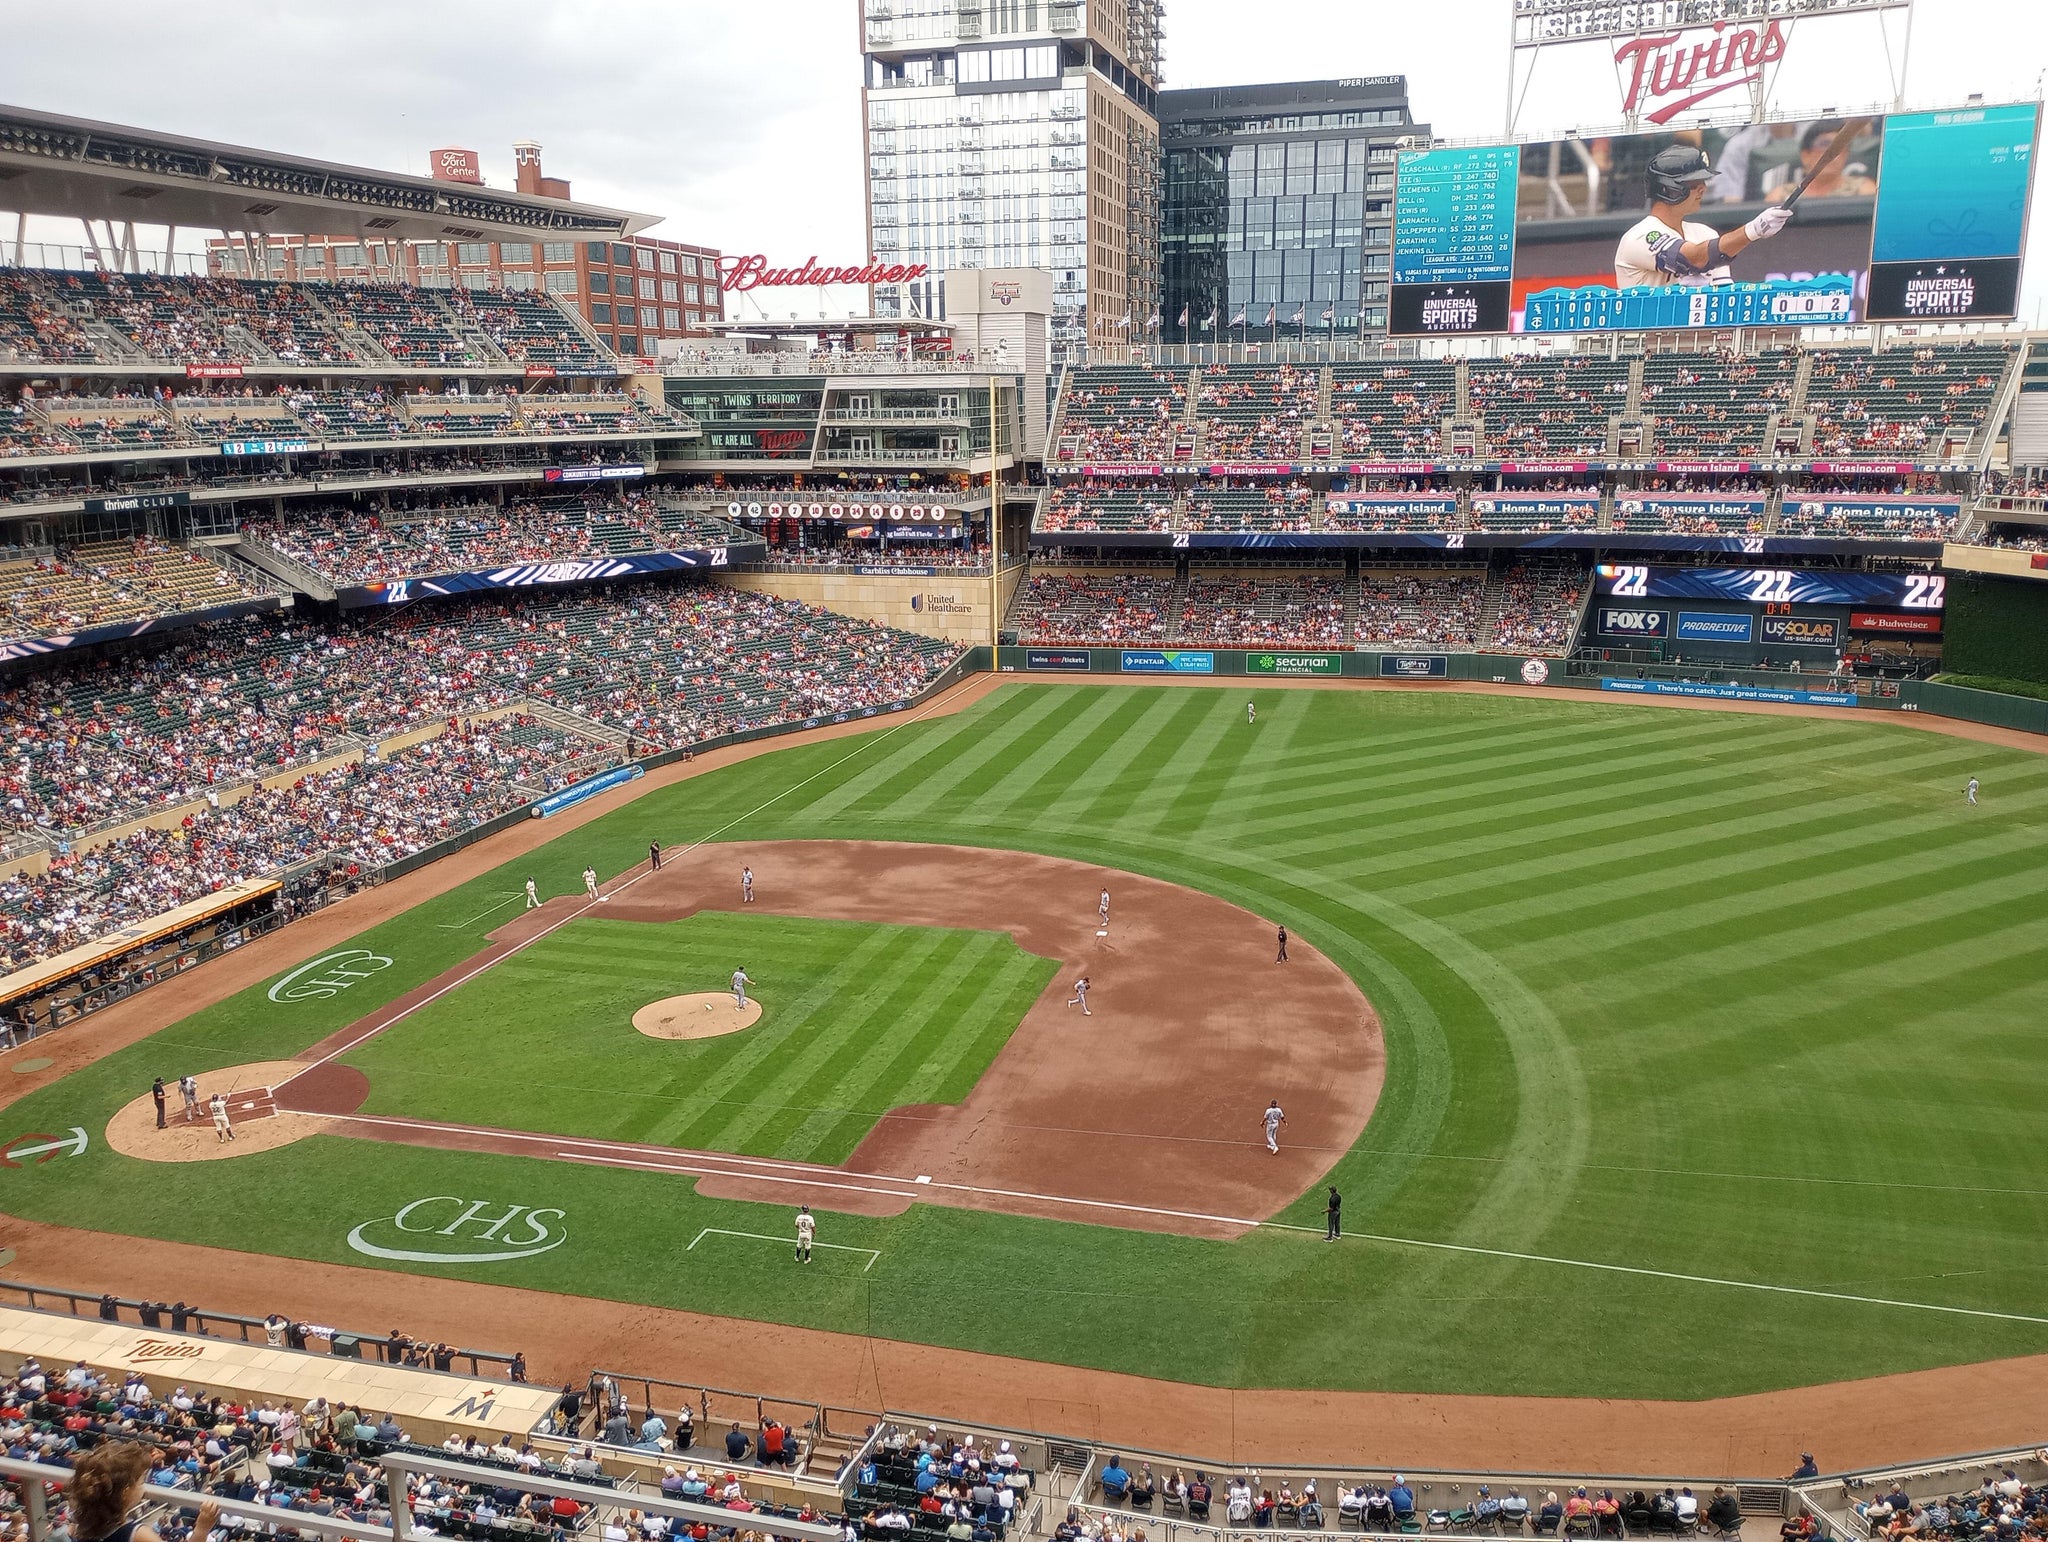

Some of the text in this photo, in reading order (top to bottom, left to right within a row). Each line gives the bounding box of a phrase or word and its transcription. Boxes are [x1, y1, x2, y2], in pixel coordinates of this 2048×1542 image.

[1615, 20, 1786, 124] Twins
[1366, 76, 1399, 85] SANDLER
[441, 152, 465, 166] Ford
[446, 166, 475, 176] Center
[714, 254, 928, 291] Budweiser
[1908, 278, 1974, 290] UNIVERSAL
[1424, 298, 1477, 309] UNIVERSAL
[1695, 295, 1769, 307] 2 2 0 3 4
[1780, 298, 1839, 312] 0 0 2
[1905, 290, 1973, 308] SPORTS
[1555, 301, 1622, 313] 1 0 0 1 0
[1911, 307, 1966, 315] AUCTIONS
[1423, 309, 1477, 324] SPORTS
[1554, 316, 1605, 328] 1 1 0 0
[1694, 310, 1767, 322] 2 3 1 2 2
[682, 396, 707, 405] WELCOME
[723, 394, 751, 406] TWINS
[756, 394, 801, 404] TERRITORY
[712, 429, 806, 458] WE ARE ALL Twins
[1092, 467, 1152, 475] Treasure Island
[1359, 465, 1424, 473] Treasure Island
[1667, 463, 1740, 472] Treasure Island
[104, 497, 174, 511] thrivent CLUB
[731, 506, 738, 514] W
[750, 506, 759, 514] 42
[1409, 503, 1445, 513] Island
[1502, 504, 1560, 512] Home Run
[792, 507, 798, 515] 7
[812, 507, 820, 515] 10
[852, 507, 861, 515] 34
[872, 507, 881, 515] 14
[1875, 507, 1901, 517] Run
[1904, 508, 1938, 518] Deck
[1173, 534, 1190, 547] 22
[1446, 534, 1464, 548] 22
[1744, 539, 1764, 553] 22
[710, 548, 728, 566] 22
[861, 567, 928, 575] Carbliss Clubhouse
[1611, 566, 1648, 596] 22
[1752, 570, 1792, 602] 22
[386, 581, 409, 603] 22
[1902, 574, 1946, 608] 22
[927, 594, 955, 604] United
[928, 603, 972, 613] Healthcare
[1766, 602, 1792, 615] 0:19
[1607, 611, 1660, 629] FOX 9
[1682, 621, 1748, 634] PROGRESSIVE
[1784, 635, 1832, 643] us-solar.com
[1276, 656, 1328, 667] securian
[1759, 692, 1795, 700] coverage.
[1809, 695, 1848, 703] PROGRESSIVE
[286, 957, 393, 999] CHS
[395, 1196, 566, 1245] CHS
[121, 1339, 206, 1363] Twins
[446, 1397, 496, 1421] M
